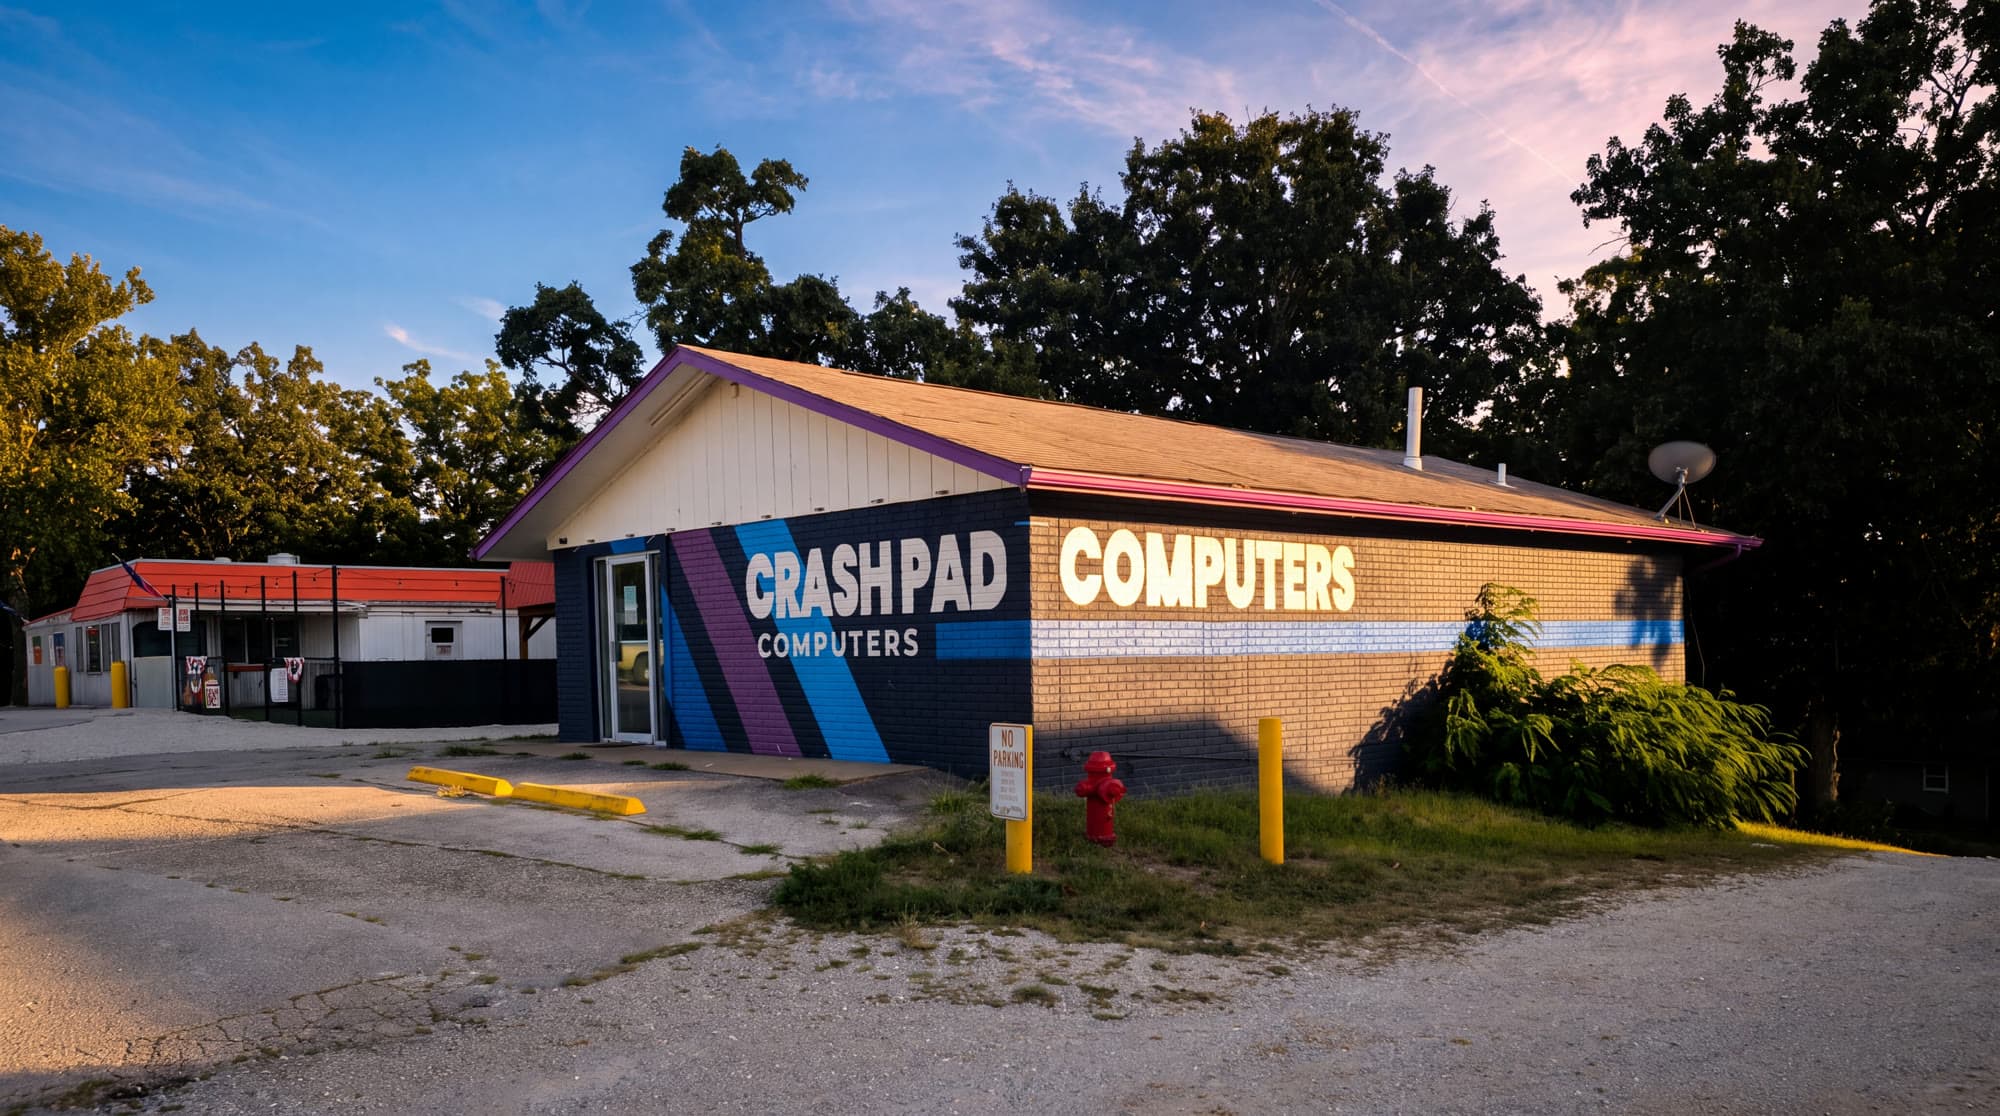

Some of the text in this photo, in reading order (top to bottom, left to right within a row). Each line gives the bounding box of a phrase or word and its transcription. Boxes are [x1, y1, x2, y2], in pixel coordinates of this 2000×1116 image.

[745, 530, 1008, 620] CRASH PAD
[1059, 526, 1356, 612] COMPUTERS
[757, 628, 919, 658] COMPUTERS
[1001, 729, 1014, 748] NO
[993, 750, 1024, 769] PARKING
